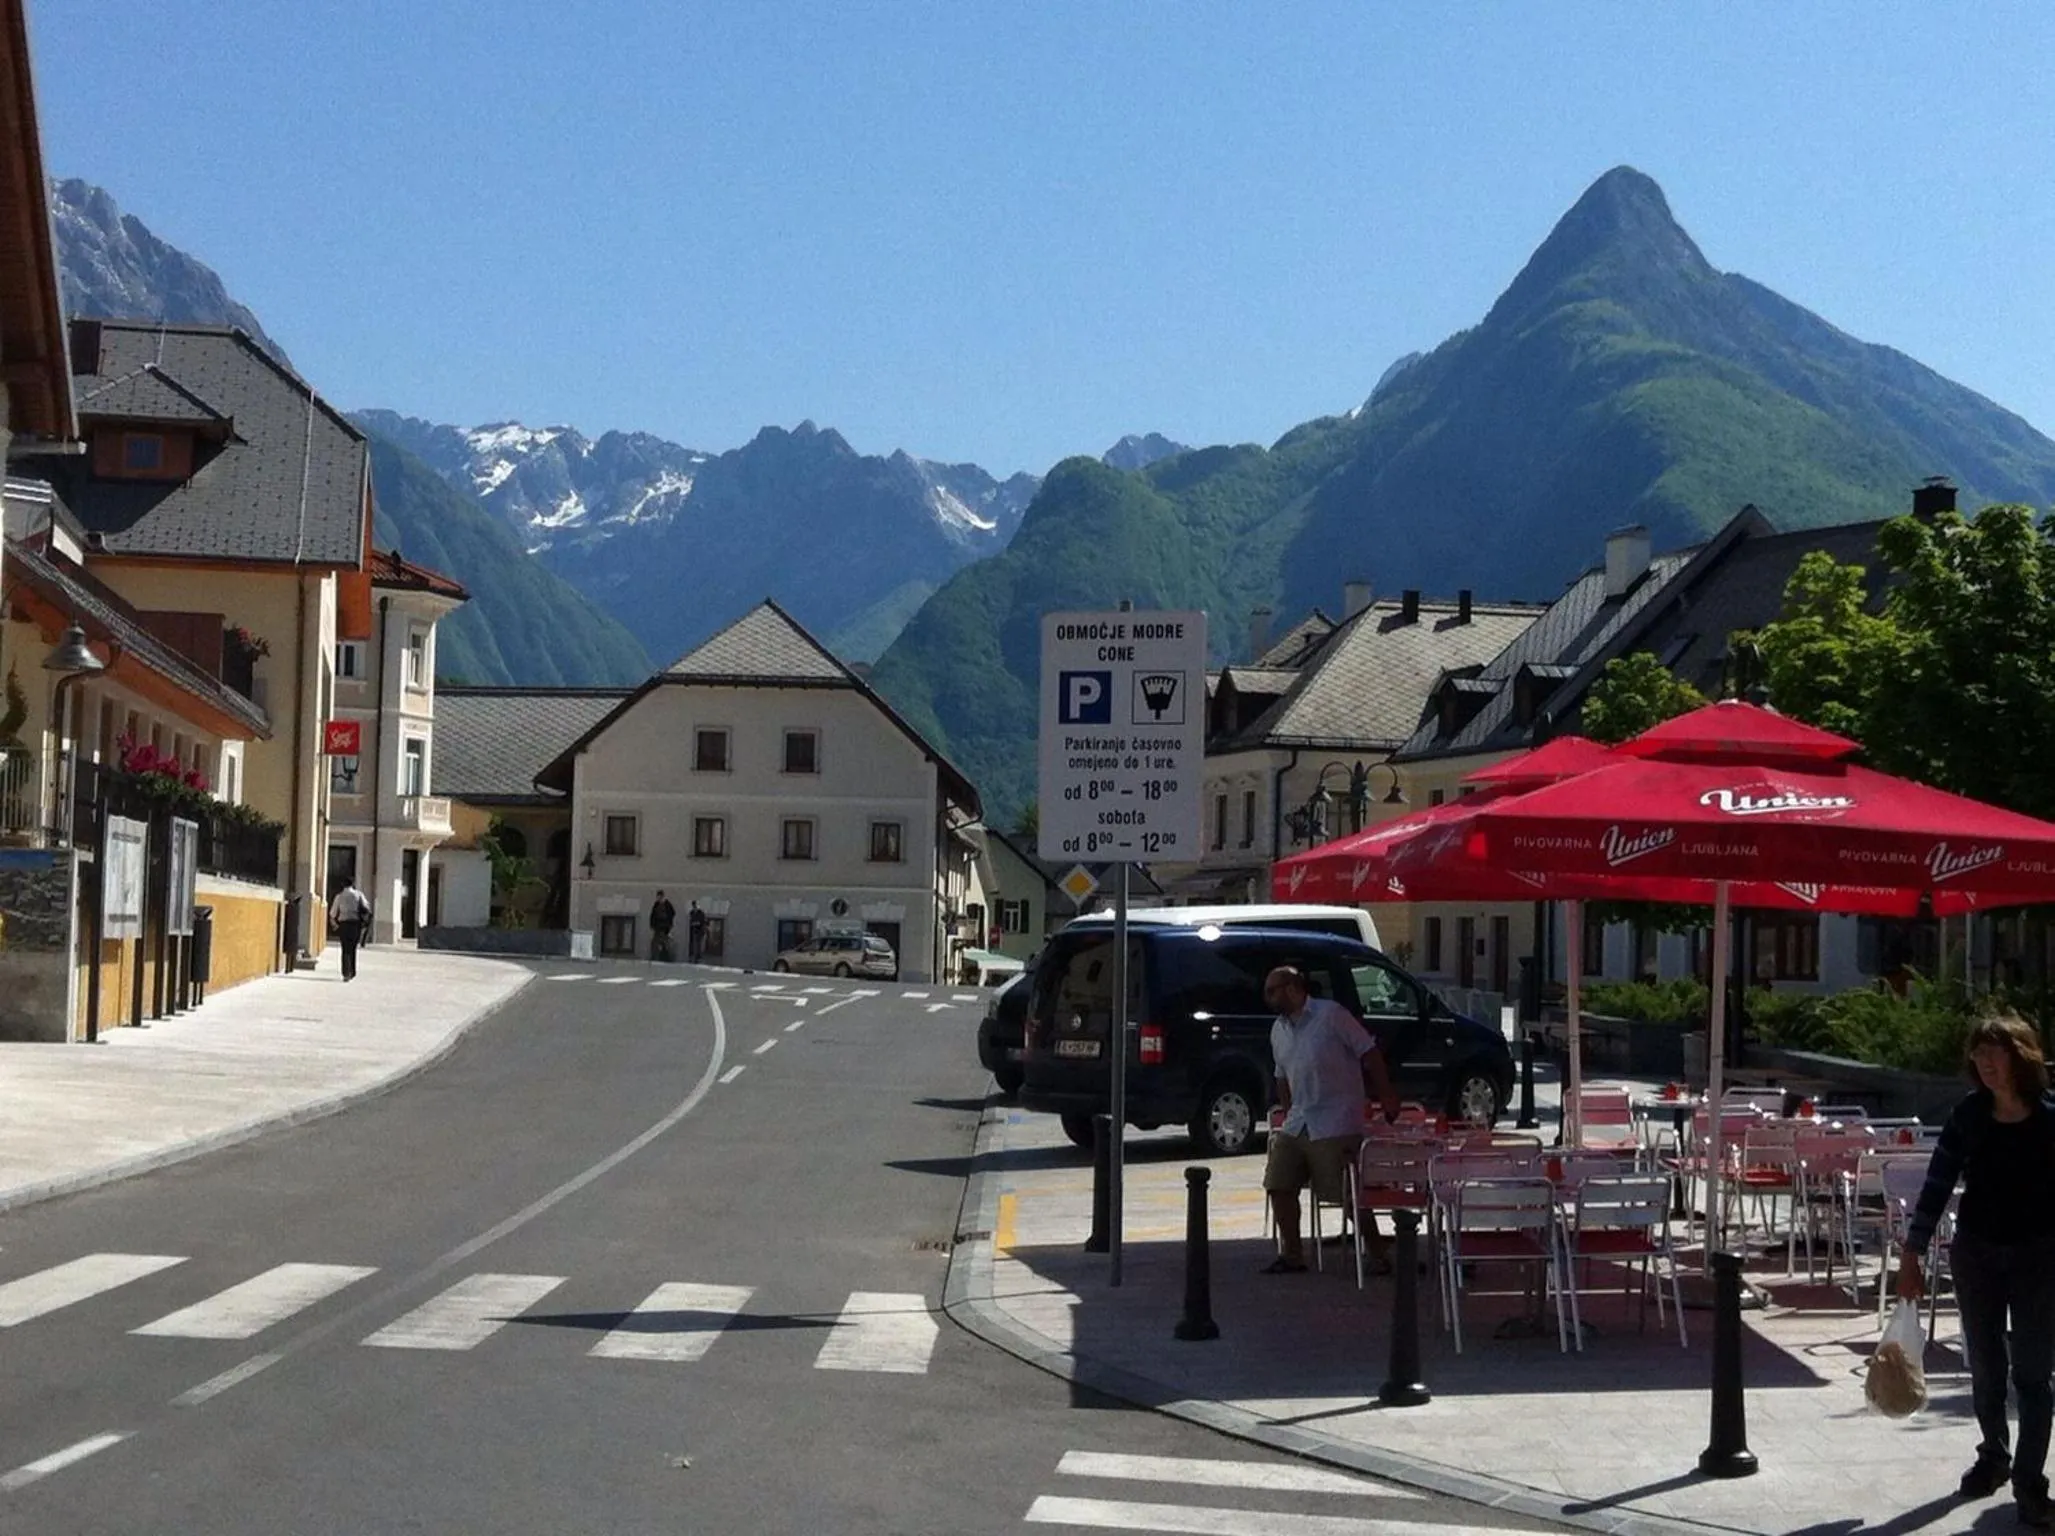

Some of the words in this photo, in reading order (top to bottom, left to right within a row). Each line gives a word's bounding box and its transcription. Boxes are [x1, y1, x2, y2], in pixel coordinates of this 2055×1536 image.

[1056, 621, 1126, 640] OBMOČJE
[1132, 624, 1184, 640] MODRE
[1097, 646, 1135, 661] CONE
[1068, 676, 1102, 720] P
[1064, 736, 1126, 752] Parkiranje
[1132, 737, 1182, 750] časovno
[1068, 757, 1119, 771] omejeno
[1124, 756, 1139, 769] do
[1145, 756, 1150, 769] 1
[1064, 784, 1082, 800] od
[1700, 789, 1858, 816] Union
[1097, 809, 1146, 825] sobota
[1063, 836, 1080, 852] od
[1514, 836, 1593, 849] PIVOVARNA
[1600, 824, 1678, 867] Union
[1681, 844, 1760, 857] LJUBLJANA
[1839, 849, 1917, 864] PIVOVARNA
[1924, 841, 2005, 882] Union
